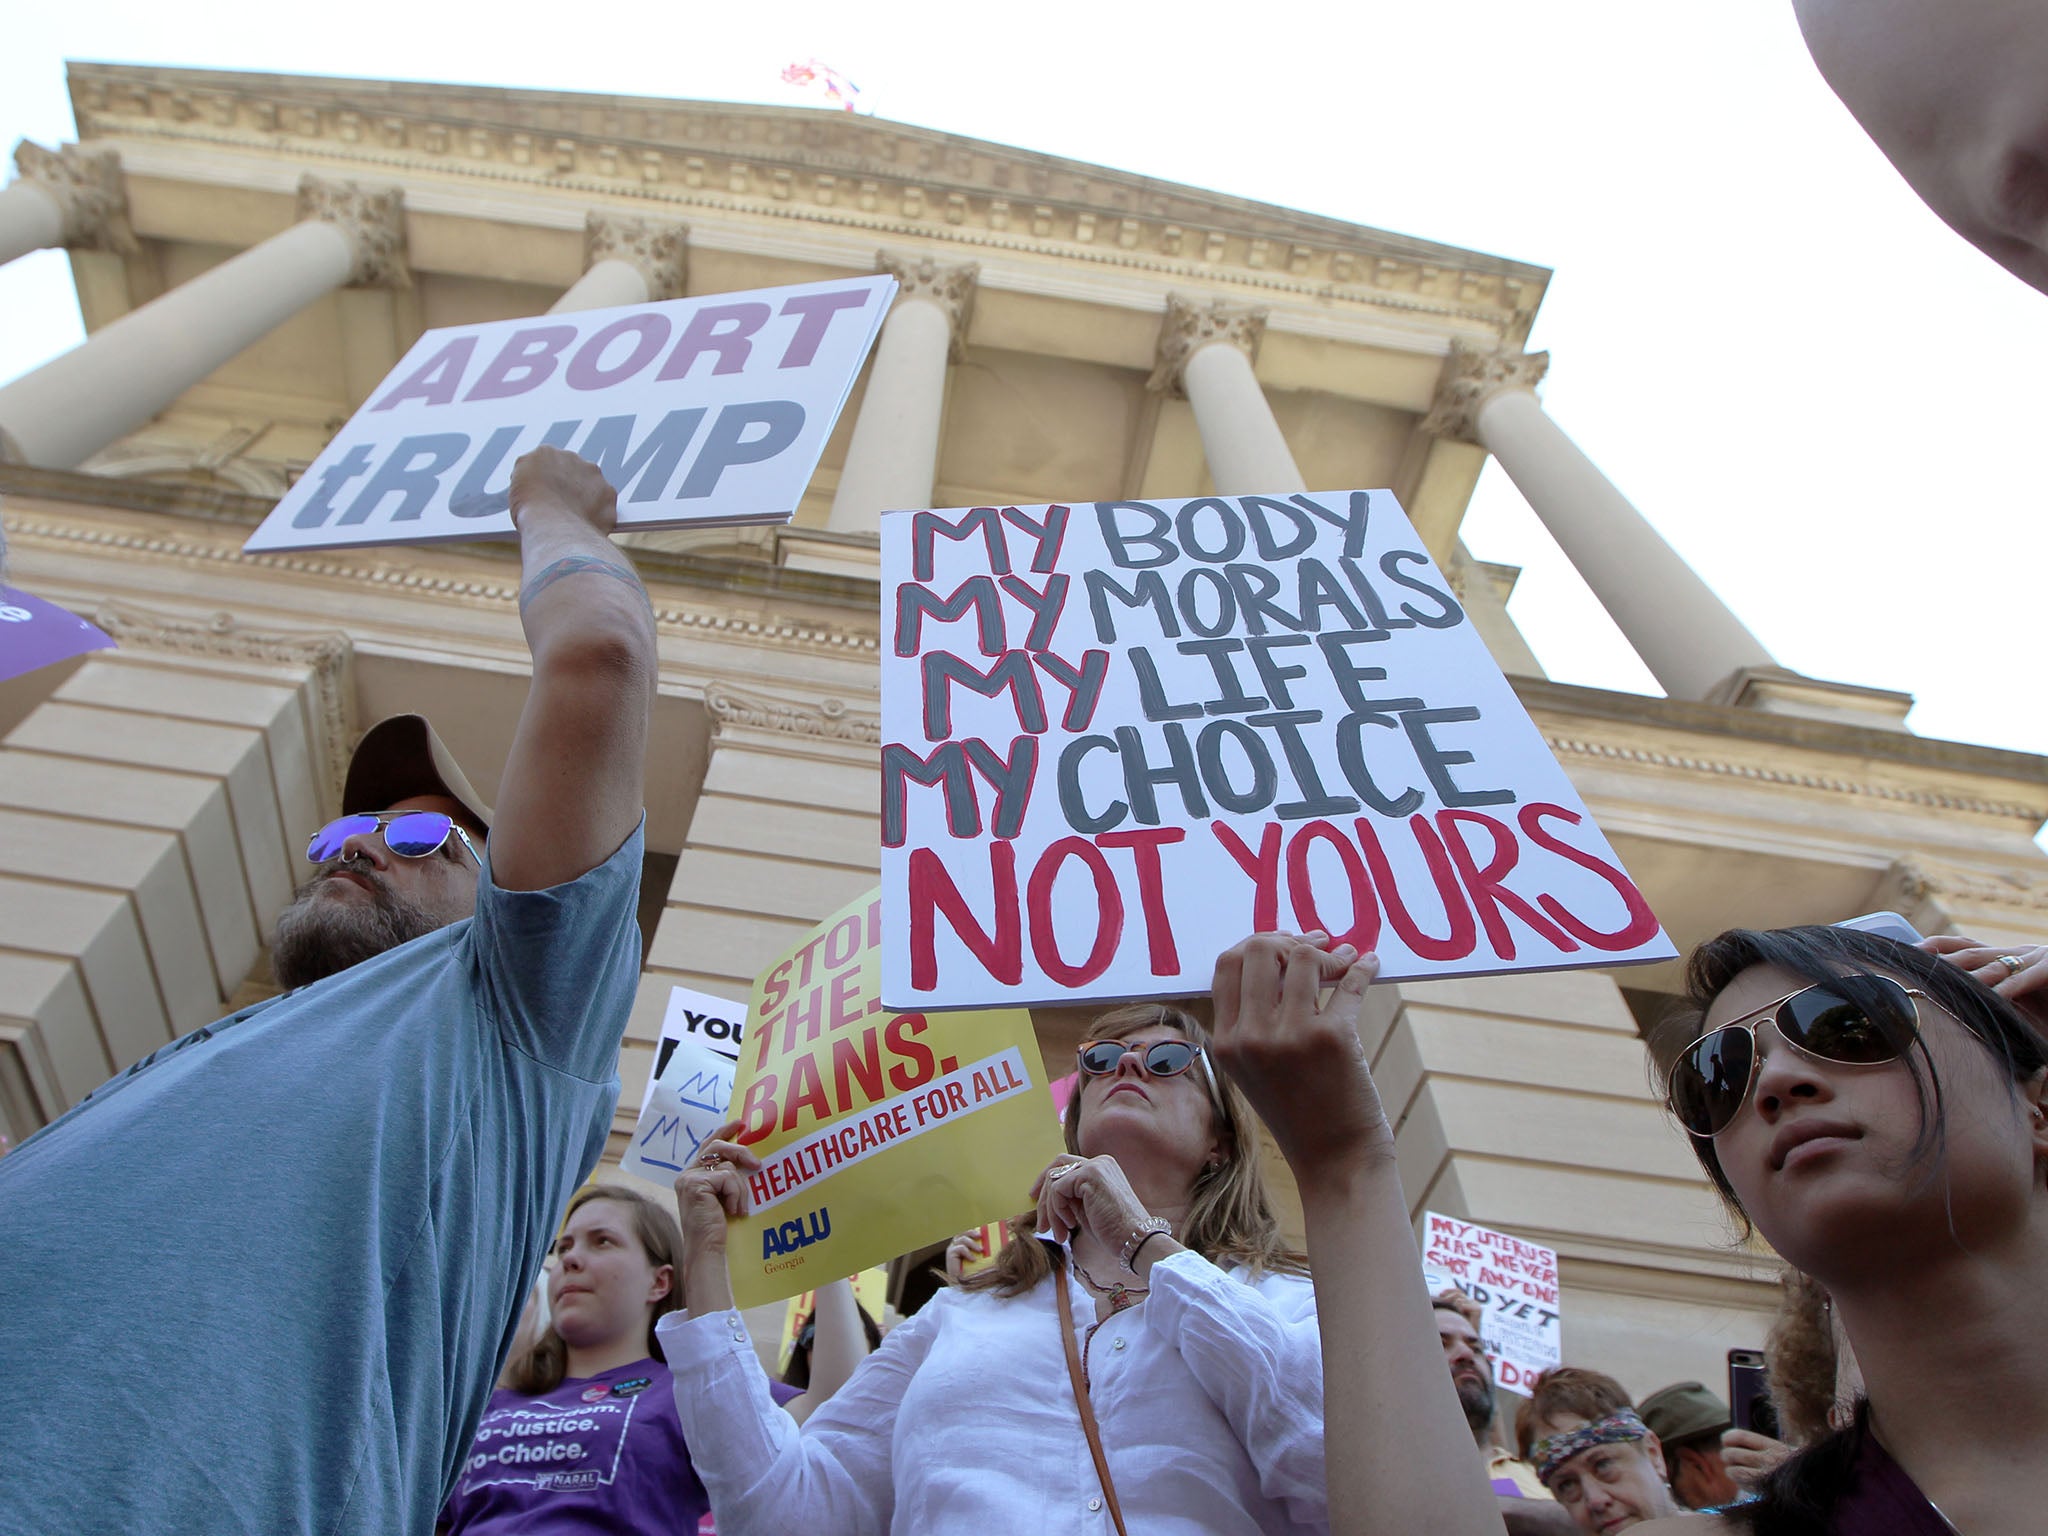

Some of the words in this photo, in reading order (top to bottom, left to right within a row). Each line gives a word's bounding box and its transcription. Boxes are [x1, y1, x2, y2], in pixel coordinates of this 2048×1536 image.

[370, 288, 872, 412] ABORT
[291, 400, 807, 530] tRUMP
[912, 504, 1071, 582] MY
[1094, 491, 1370, 569] BODY
[894, 573, 1071, 658] MY
[1083, 550, 1464, 644] MORALS
[920, 649, 1110, 742] MY
[1127, 629, 1426, 721] LIFE
[881, 735, 1039, 847] MY
[1057, 705, 1517, 834] CHOICE
[908, 827, 1187, 991] NOT
[1211, 801, 1660, 961] YOURS
[678, 1071, 734, 1113] M
[737, 1012, 959, 1147] BANS.
[640, 1114, 714, 1165] MY
[748, 1108, 912, 1206] HEALTHCARE
[913, 1079, 969, 1128] FOR
[973, 1060, 1024, 1103] ALL
[762, 1206, 832, 1260] ACLU
[1431, 1217, 1473, 1238] MY
[1478, 1230, 1553, 1267] UTERUS
[1432, 1235, 1483, 1259] HAS
[764, 1255, 806, 1276] Georgia
[1478, 1267, 1558, 1305] ANYONE
[1495, 1294, 1559, 1327] YET
[476, 1418, 600, 1442] o-Justice.
[465, 1441, 588, 1474] ro-Choice.
[553, 1473, 596, 1485] NARAL
